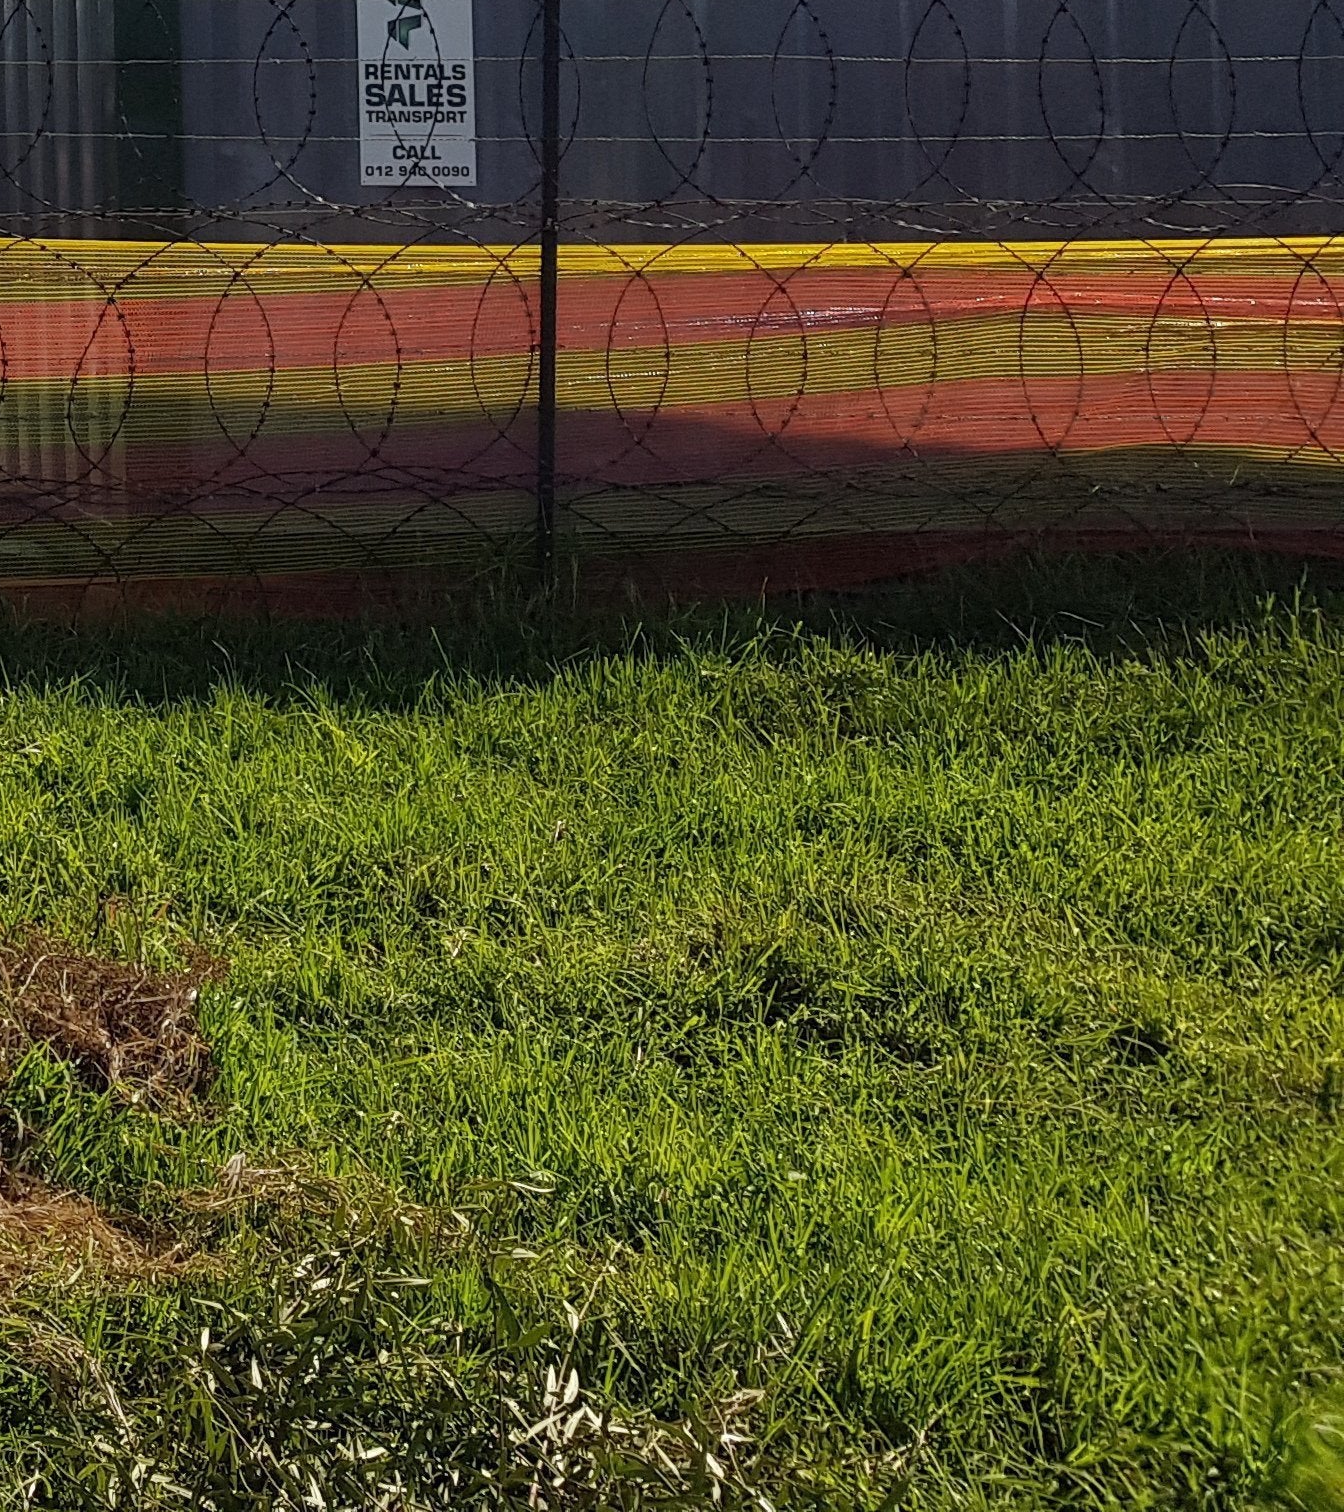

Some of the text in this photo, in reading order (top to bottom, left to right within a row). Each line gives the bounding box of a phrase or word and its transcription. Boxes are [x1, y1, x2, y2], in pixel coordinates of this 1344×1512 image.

[365, 64, 465, 80] RENTALS
[366, 84, 466, 107] SALES
[366, 111, 467, 123] TRANSPORT
[393, 145, 441, 160] CALL
[365, 166, 393, 176] 012
[432, 166, 469, 177] 0090
